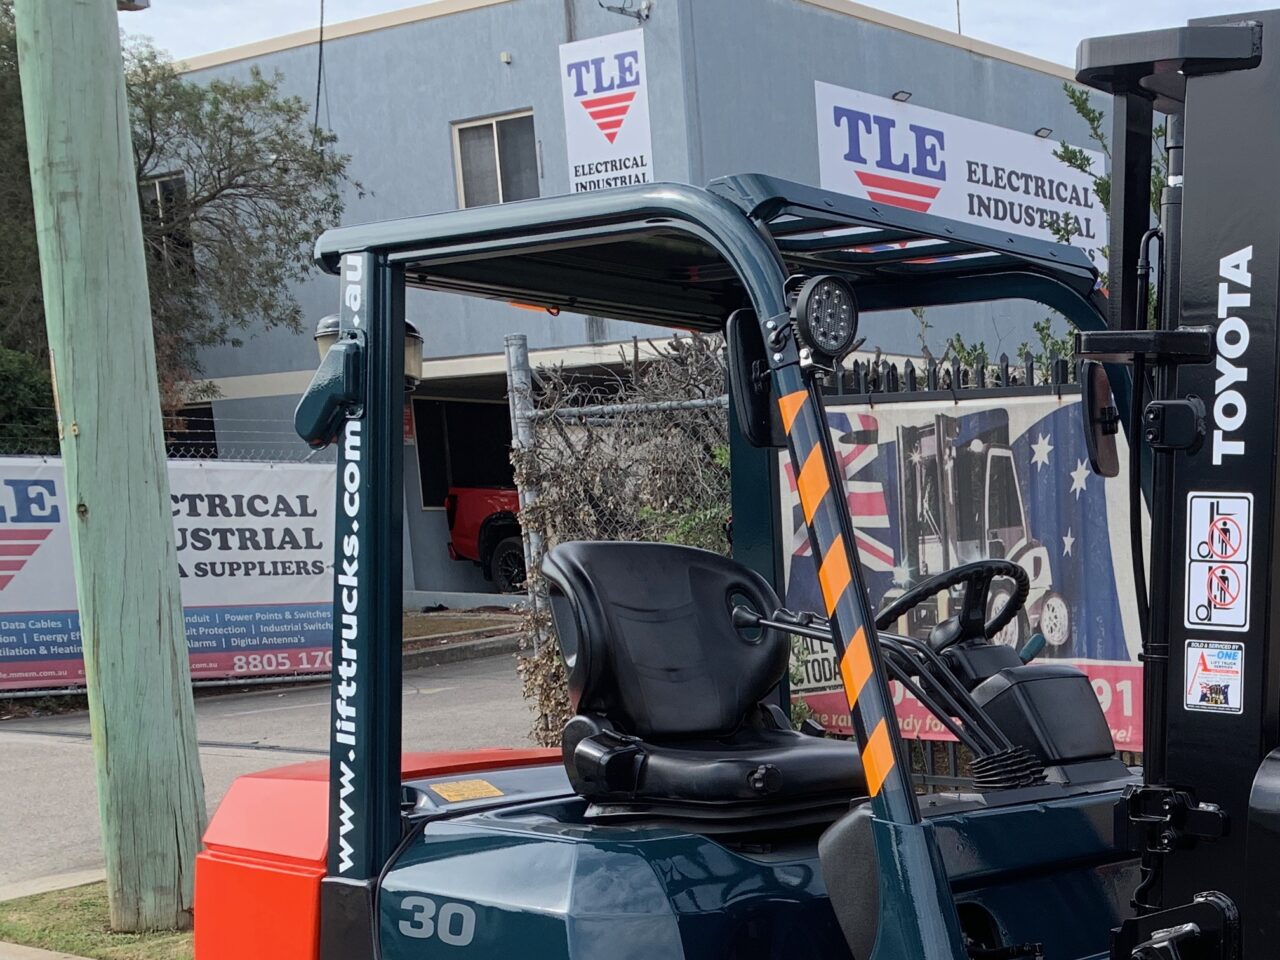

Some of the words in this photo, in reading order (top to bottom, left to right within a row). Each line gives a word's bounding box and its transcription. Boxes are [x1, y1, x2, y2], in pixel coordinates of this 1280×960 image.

[567, 50, 640, 98] TLE
[833, 105, 947, 182] TLE
[574, 155, 648, 178] ELECTRICAL
[574, 172, 650, 193] INDUSTRIAL
[966, 160, 1094, 209] ELECTRICAL
[967, 193, 1096, 239] INDUSTRAL
[1212, 244, 1253, 466] TOYOTA
[0, 479, 61, 523] E
[194, 560, 325, 577] SUPPLIERS
[1, 621, 26, 630] Data
[28, 619, 62, 629] Cables
[224, 613, 253, 622] Power
[255, 612, 283, 621] Points
[284, 611, 292, 619] &
[293, 610, 332, 619] Switches
[33, 633, 68, 643] Energy
[199, 625, 246, 634] Protection
[260, 623, 302, 633] Industrial
[231, 636, 260, 647] Digital
[262, 635, 305, 645] Antenna's
[233, 653, 291, 673] 8805
[399, 896, 476, 947] 30
